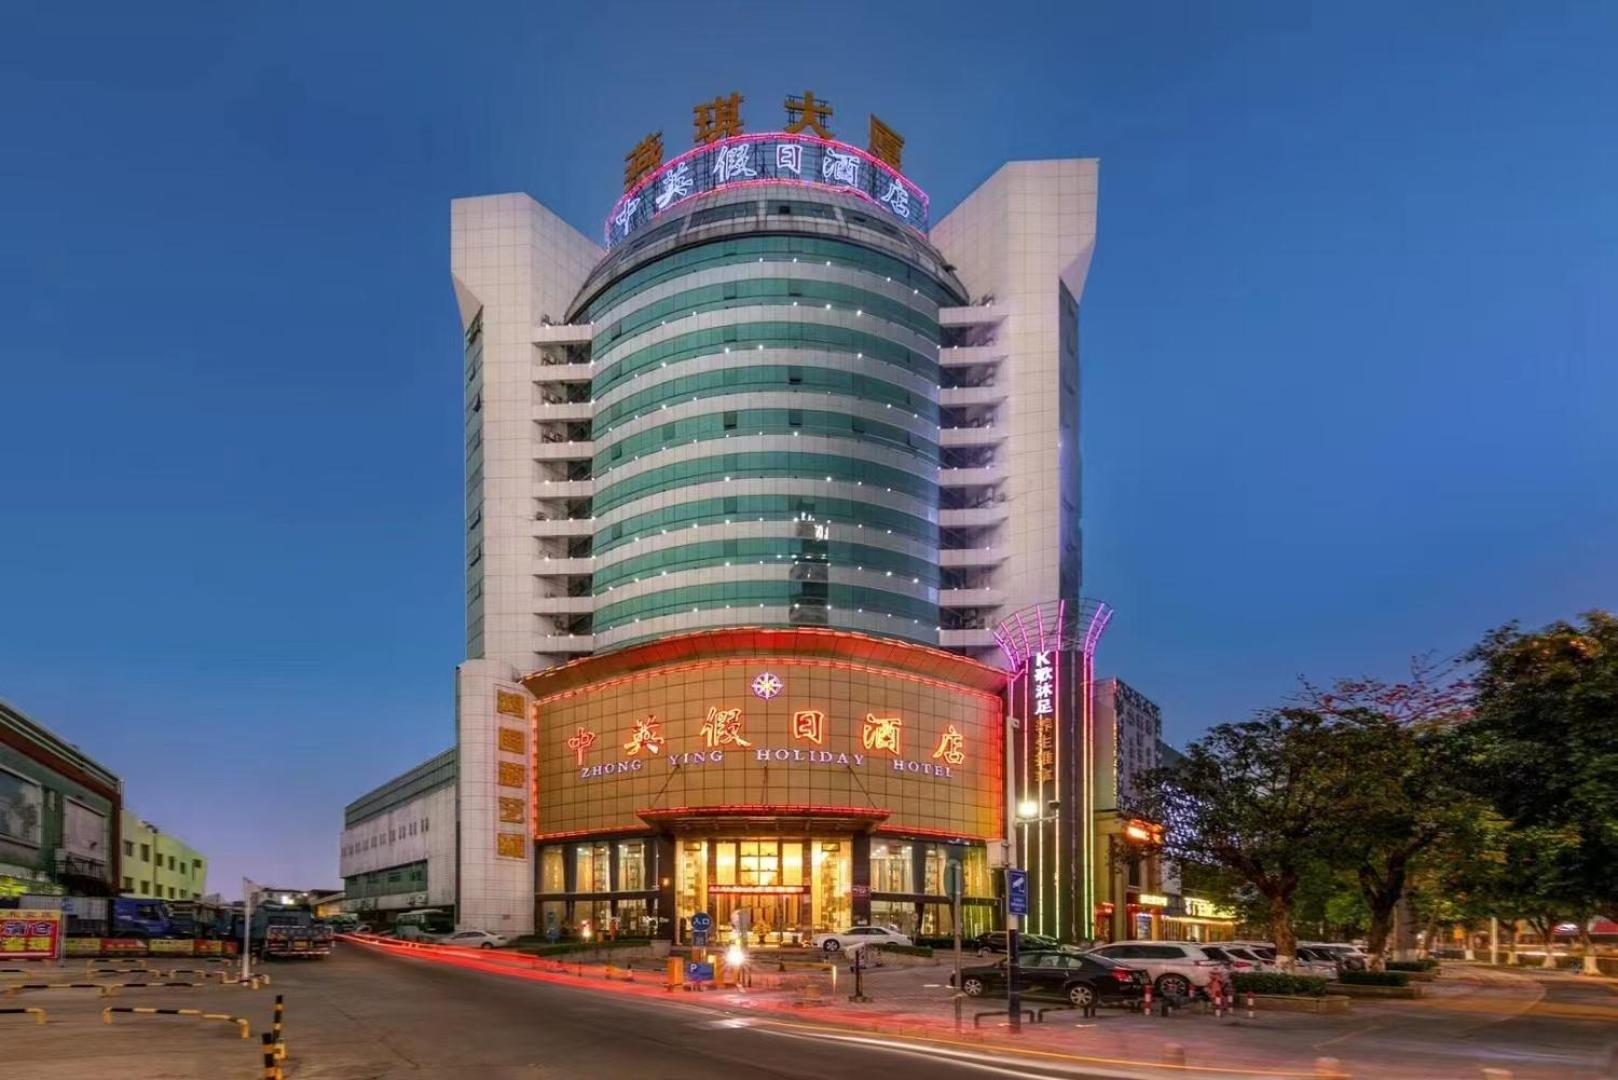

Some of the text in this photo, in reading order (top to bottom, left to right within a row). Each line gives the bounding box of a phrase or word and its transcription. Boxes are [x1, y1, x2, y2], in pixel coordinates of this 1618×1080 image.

[615, 143, 910, 236] 中英假日酒店
[1033, 651, 1054, 715] K歌沐足
[567, 705, 965, 767] 中英假日酒店
[581, 748, 954, 778] ZHONG YING HOLIDAY HOTEL
